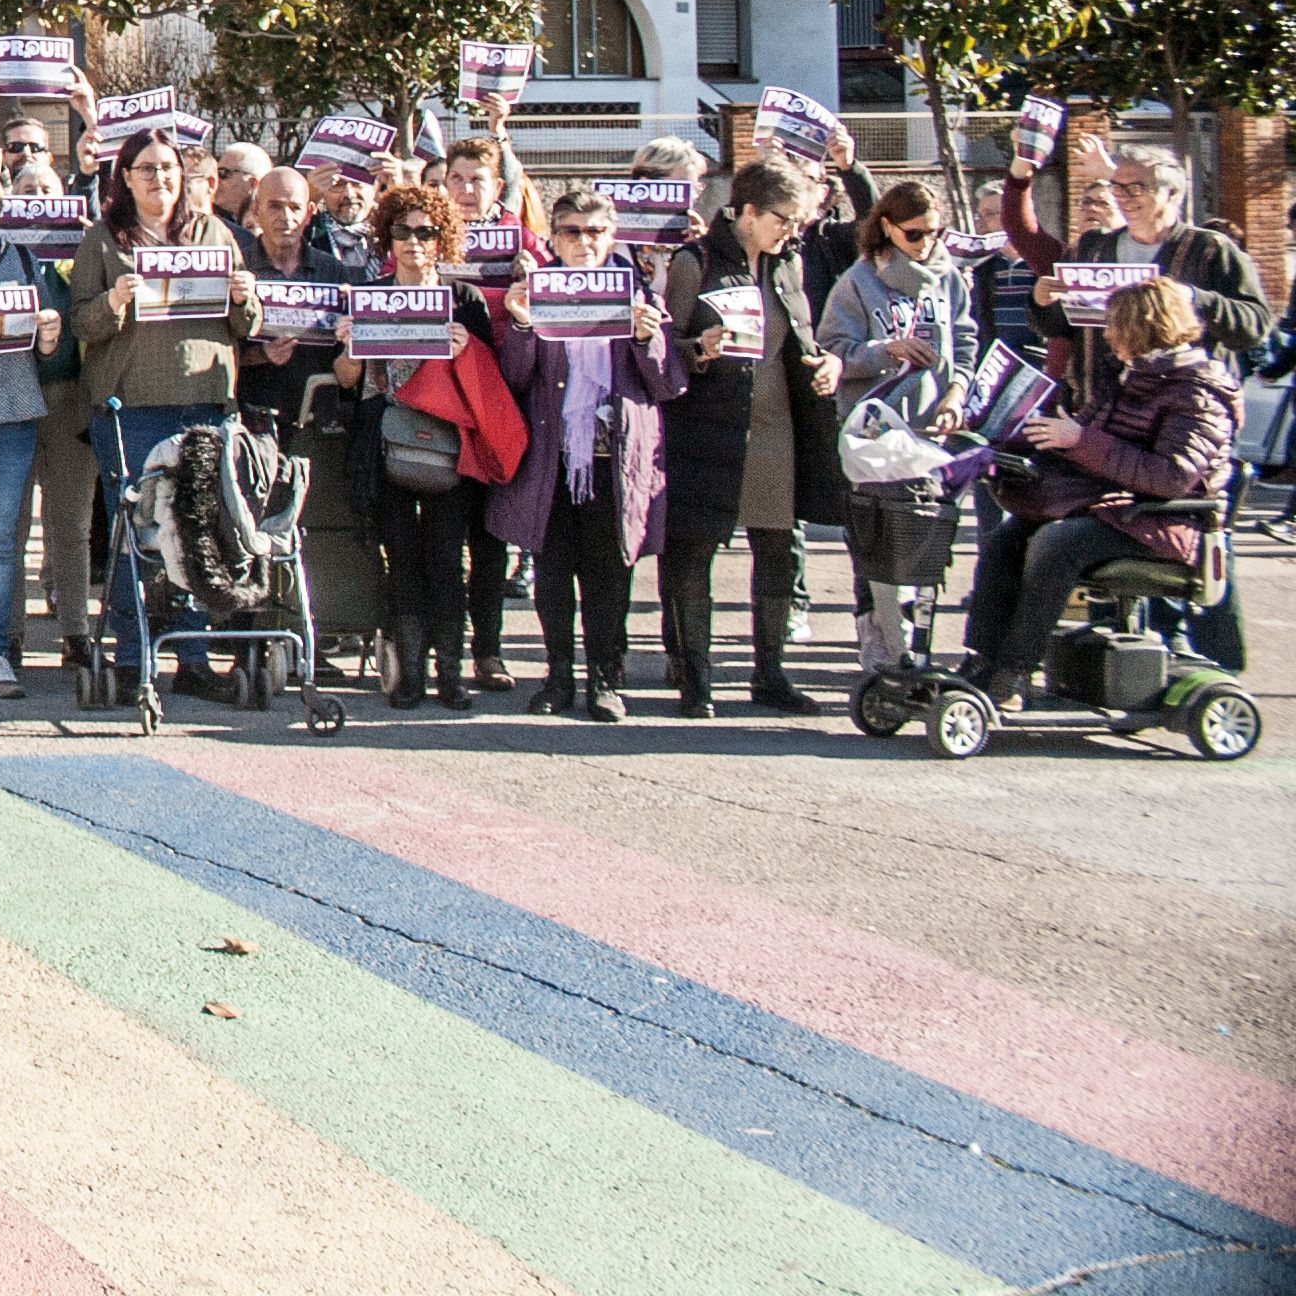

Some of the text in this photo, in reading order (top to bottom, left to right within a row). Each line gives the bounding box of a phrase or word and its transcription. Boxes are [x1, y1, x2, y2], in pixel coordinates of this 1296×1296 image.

[142, 251, 226, 273] PROU!!
[533, 273, 624, 295] PROU!!
[355, 292, 443, 313] PROU!!
